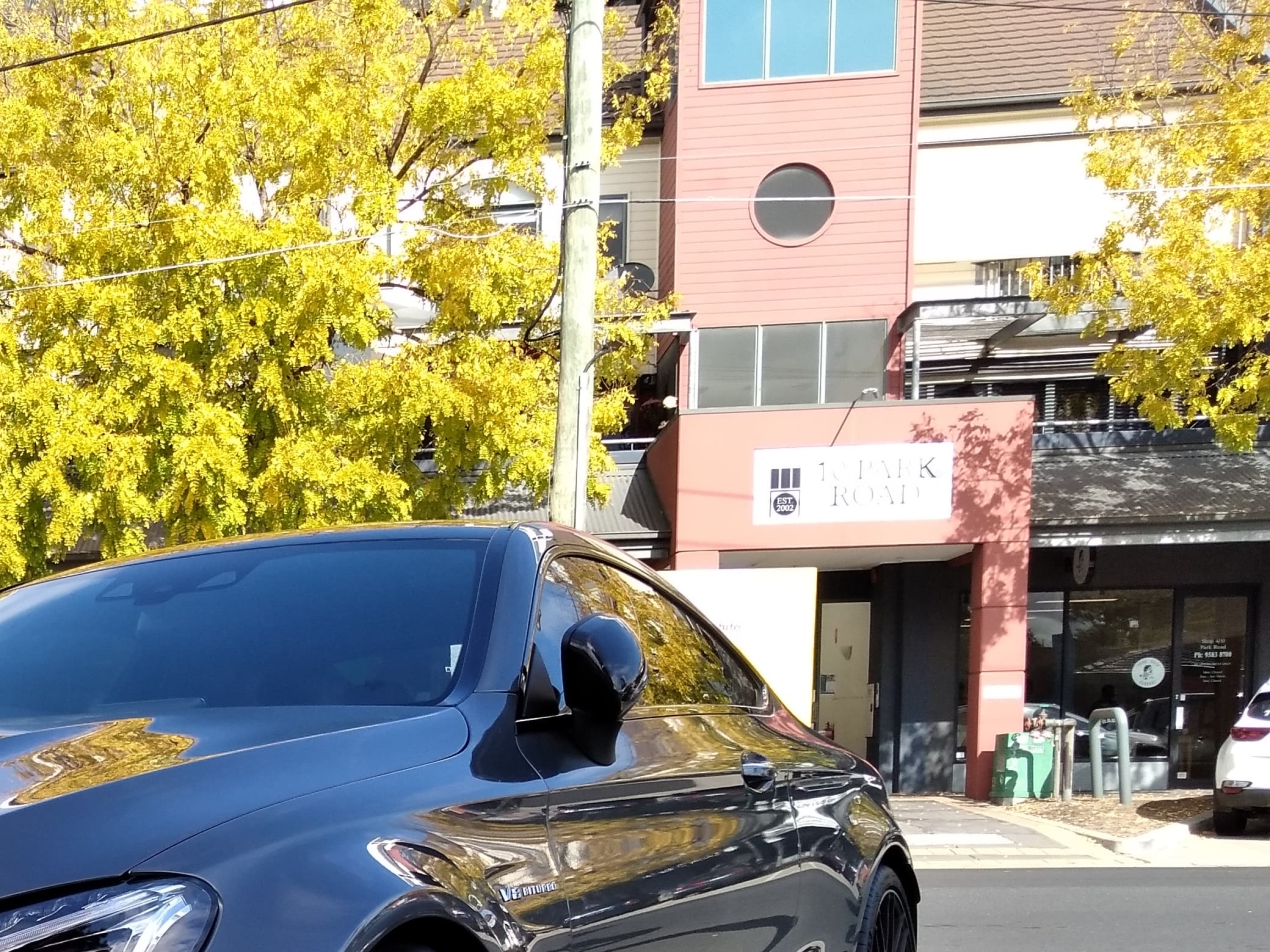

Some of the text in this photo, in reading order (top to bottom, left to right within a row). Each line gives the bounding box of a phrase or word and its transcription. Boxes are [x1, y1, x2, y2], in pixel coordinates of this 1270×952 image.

[858, 457, 936, 480] PARK
[776, 504, 794, 512] 2002
[500, 881, 557, 902] V8 BITURBO
